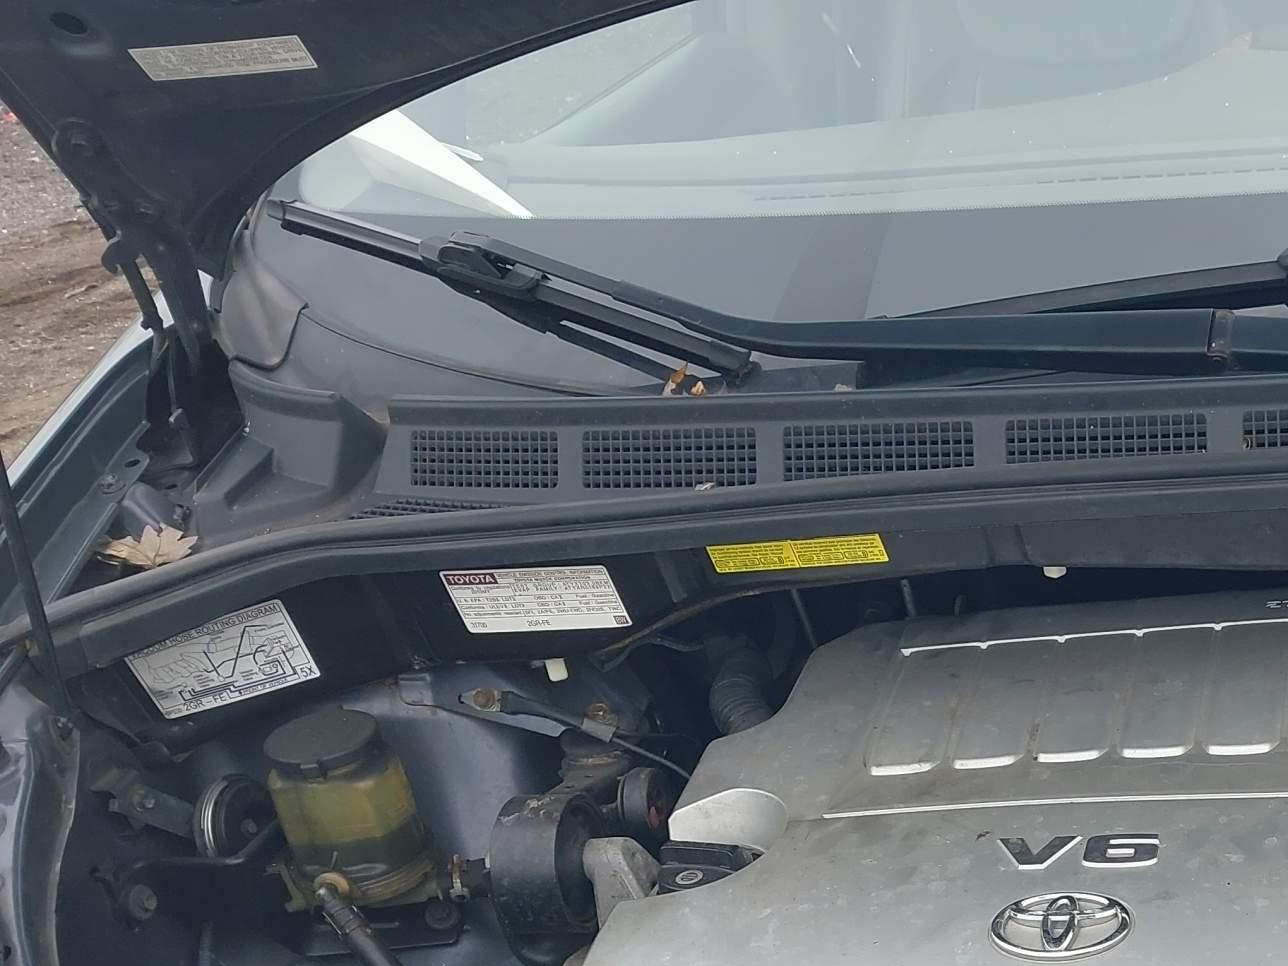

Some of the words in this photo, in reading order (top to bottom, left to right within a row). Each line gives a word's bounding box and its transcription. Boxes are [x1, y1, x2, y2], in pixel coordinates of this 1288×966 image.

[446, 574, 495, 584] TOYOTA
[194, 617, 238, 636] ROUTING
[236, 603, 278, 626] DIAGRAM
[300, 666, 316, 678] 5X
[997, 833, 1160, 870] V6
